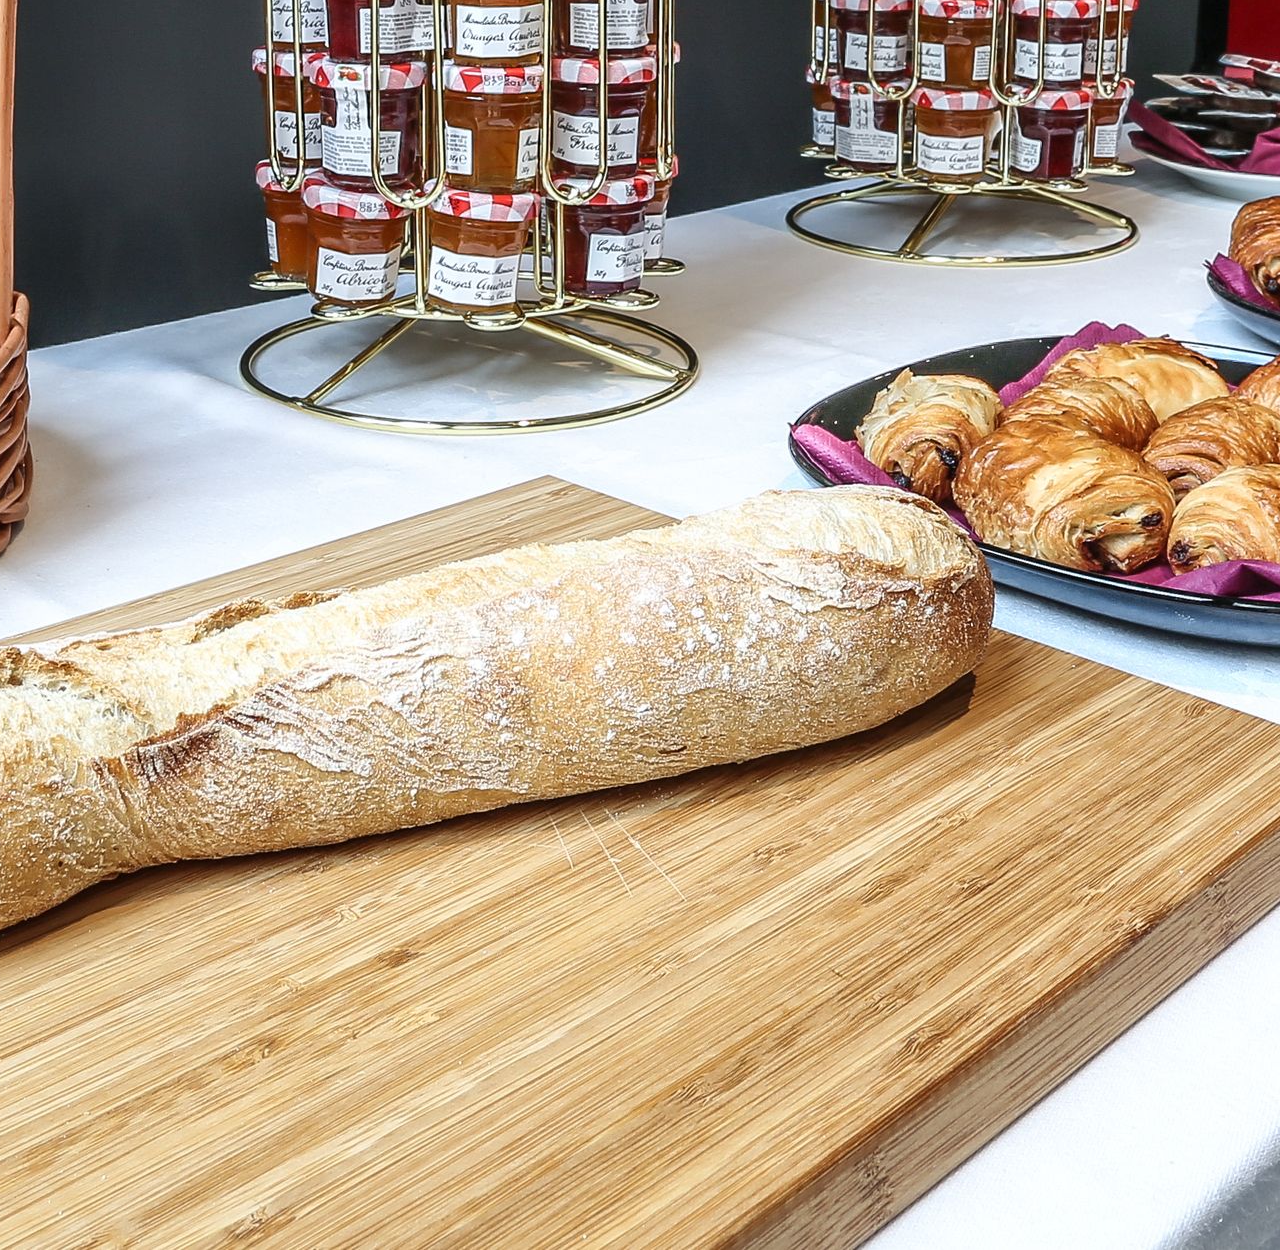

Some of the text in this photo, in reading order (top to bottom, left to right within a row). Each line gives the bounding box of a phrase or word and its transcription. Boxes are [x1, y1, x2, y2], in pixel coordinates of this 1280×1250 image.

[462, 28, 504, 45] Oranges
[354, 258, 378, 272] Bonne
[336, 273, 389, 287] Abricots
[434, 270, 472, 290] Oranges
